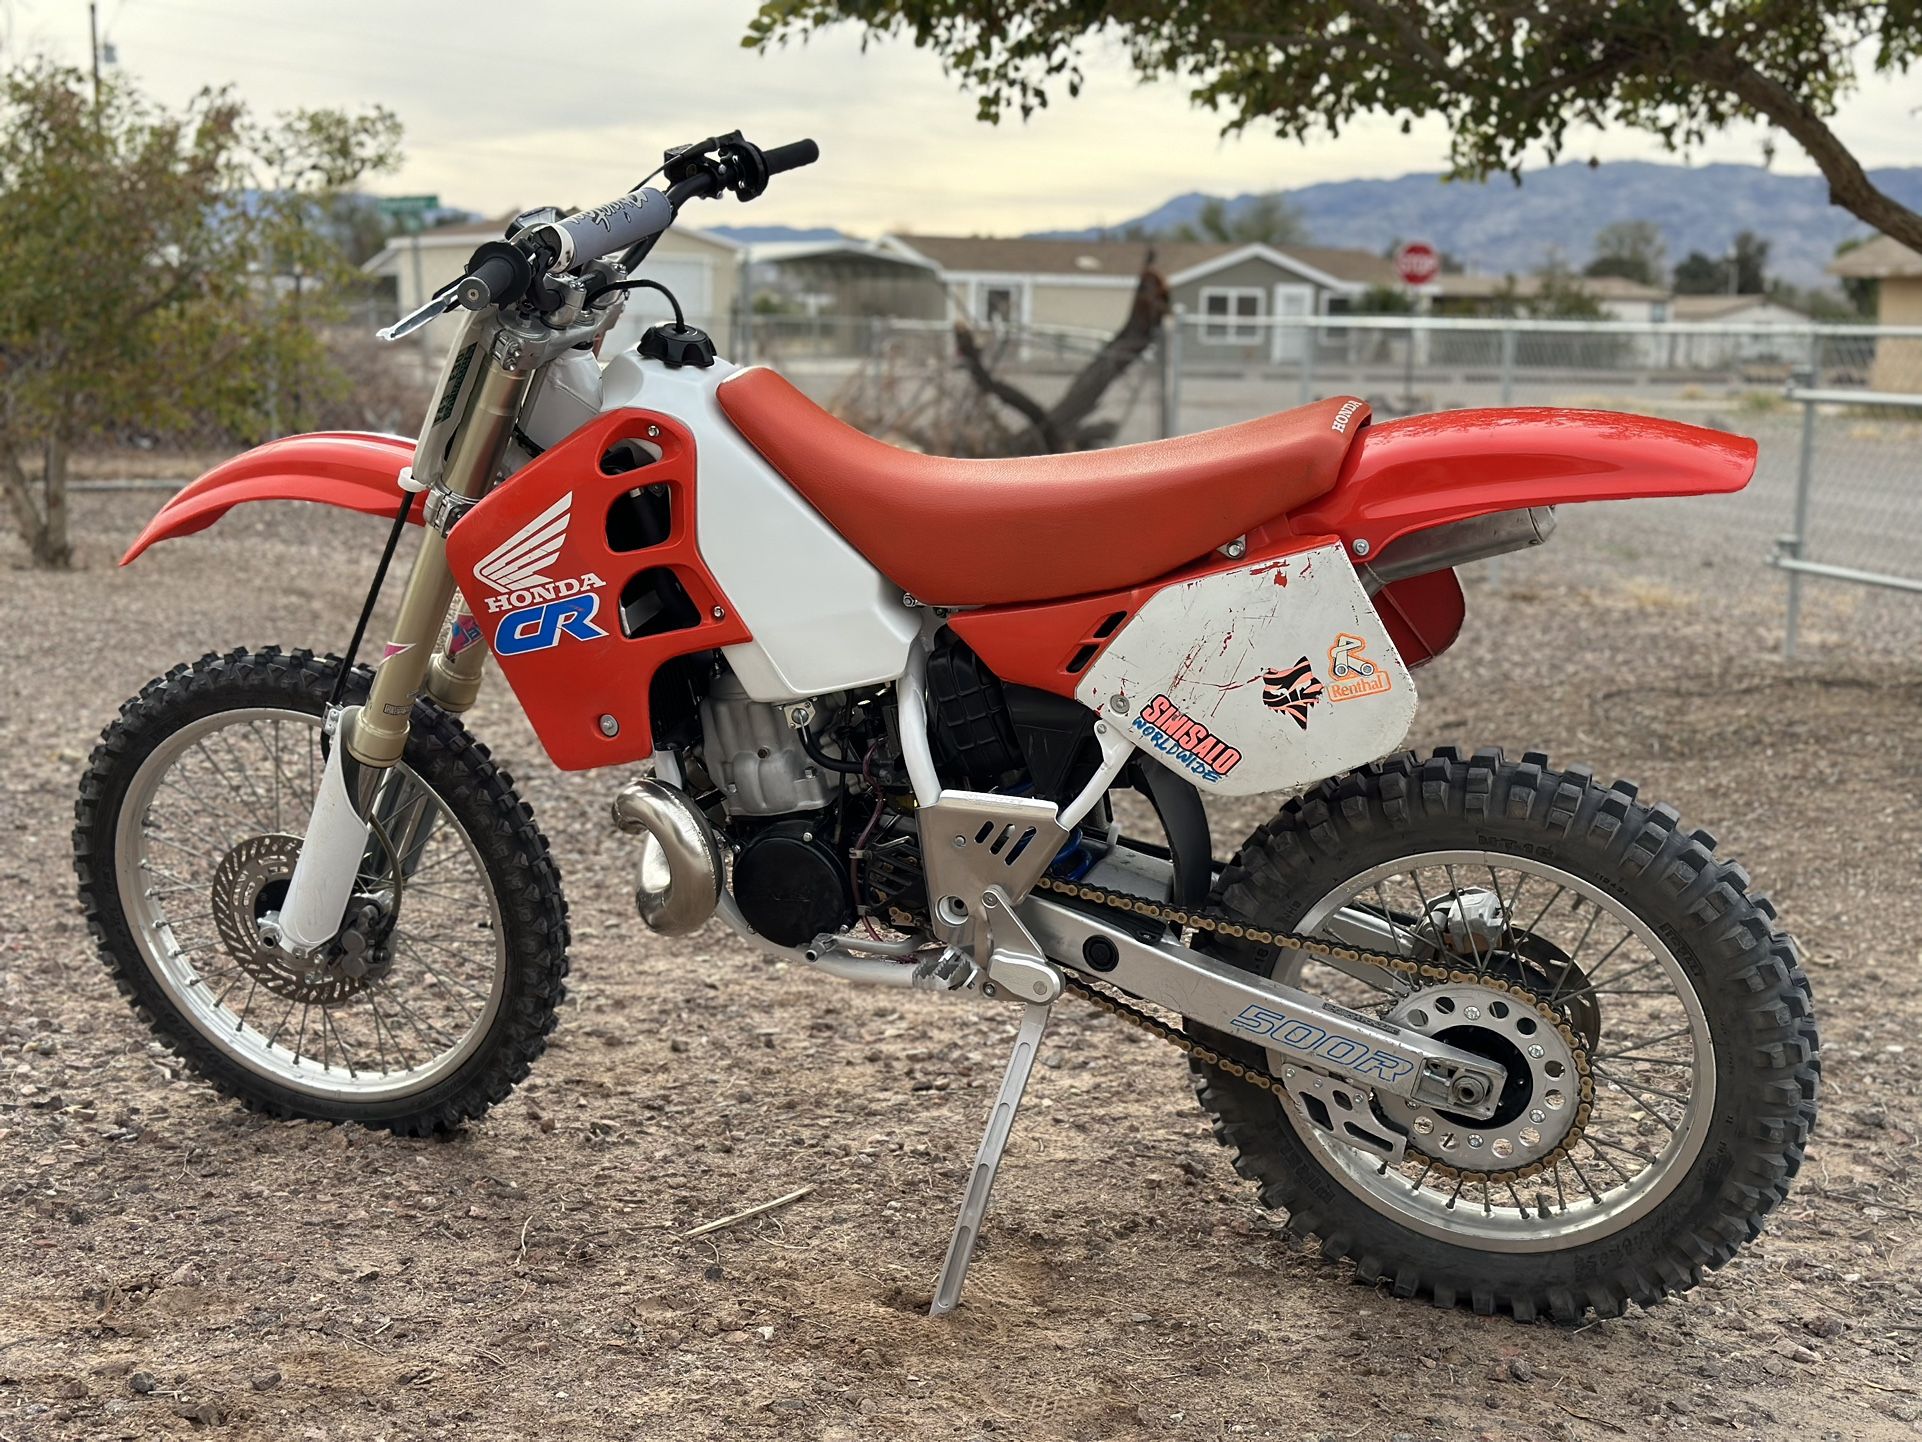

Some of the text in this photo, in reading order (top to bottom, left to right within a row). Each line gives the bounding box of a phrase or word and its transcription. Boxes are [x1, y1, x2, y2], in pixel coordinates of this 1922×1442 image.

[1331, 400, 1363, 433] HONDA
[485, 573, 607, 613] HONDA
[494, 592, 609, 656] CR
[1331, 674, 1384, 698] Renthal
[1132, 716, 1222, 783] WORLDWIDE
[1140, 693, 1243, 776] SINISALO
[1230, 1004, 1414, 1083] 500R
